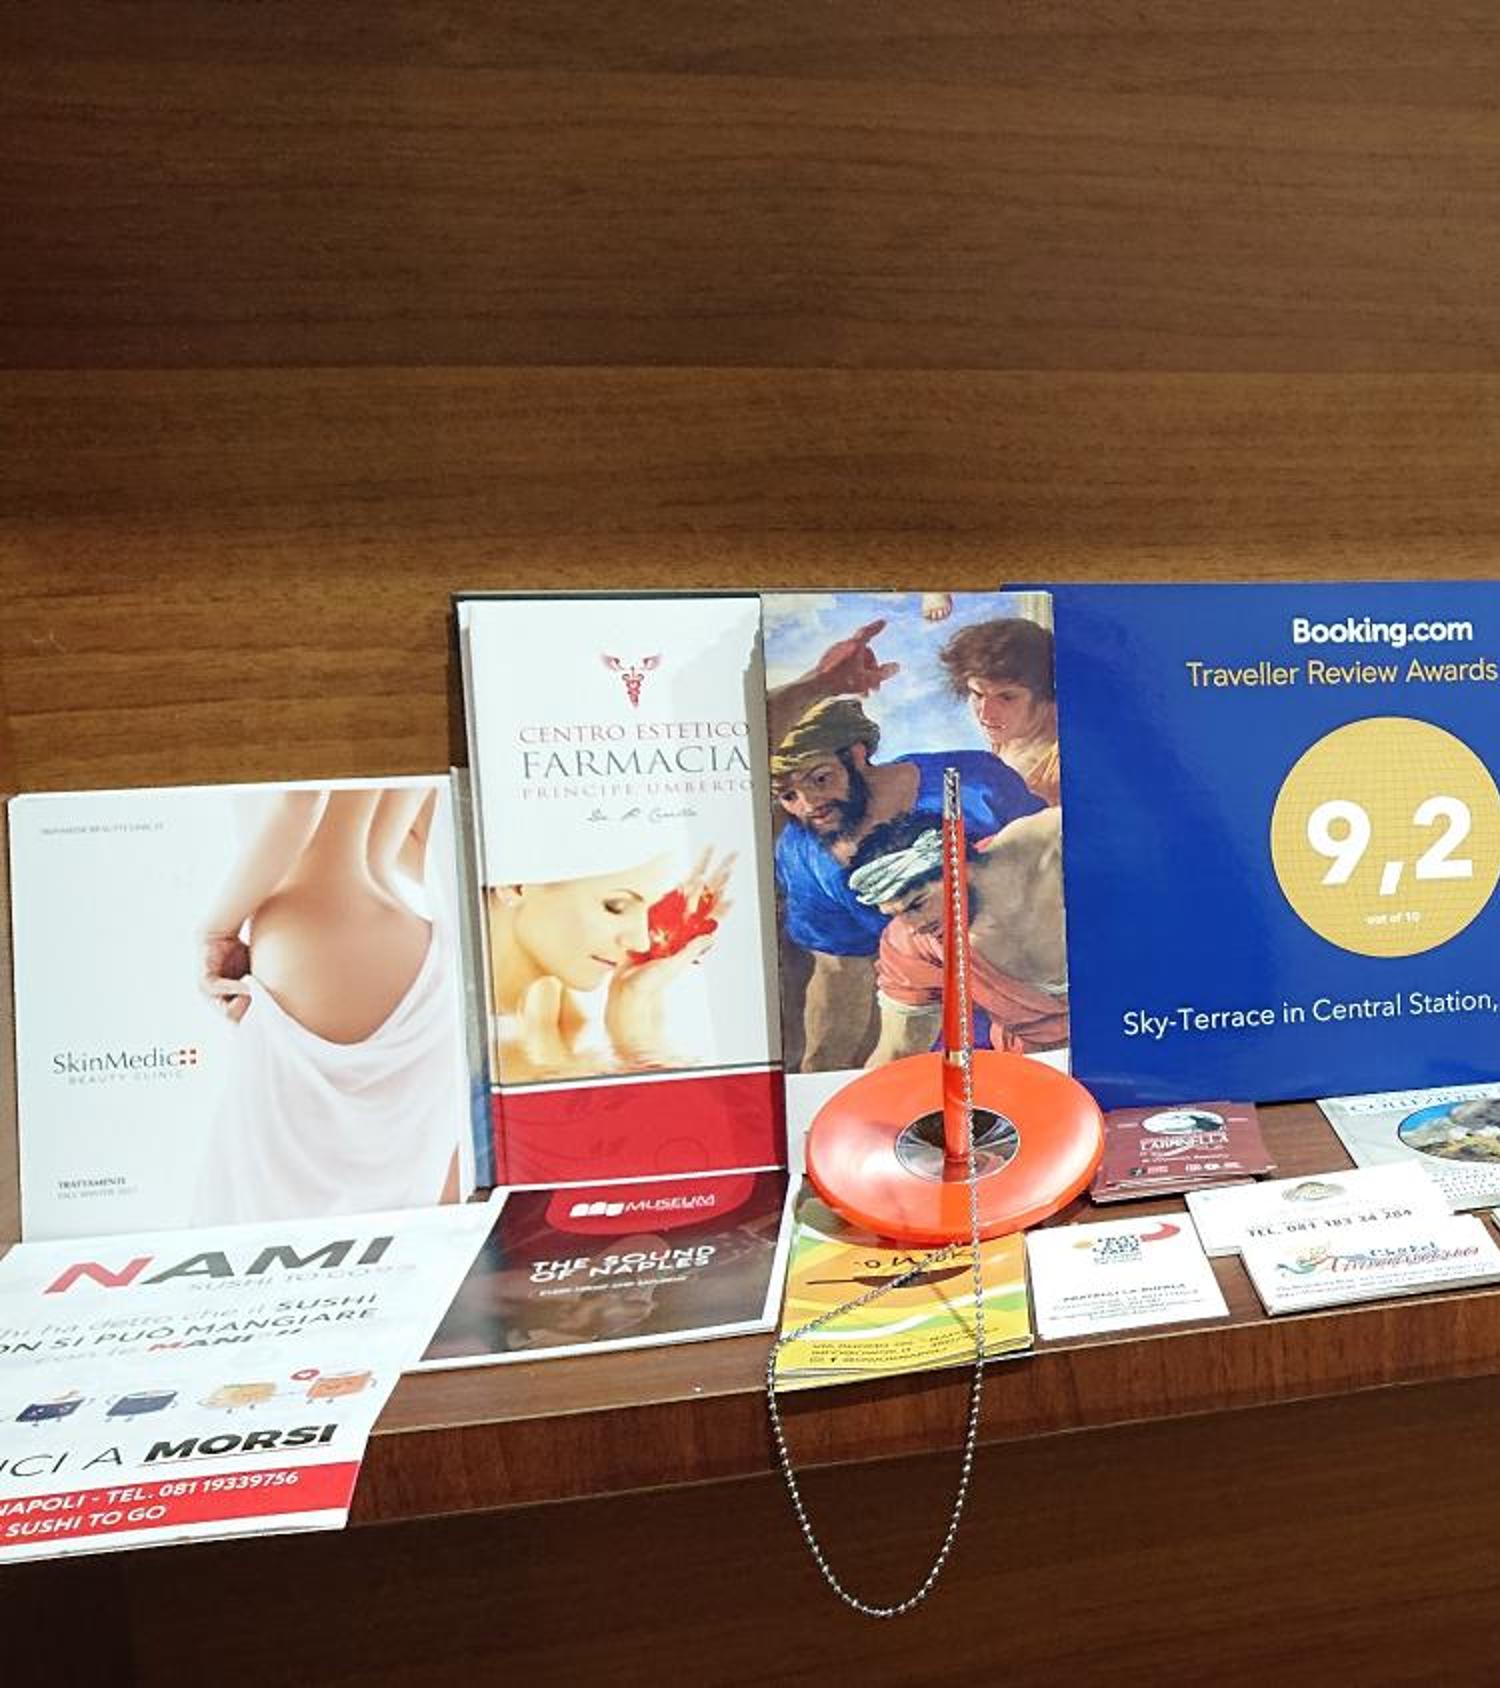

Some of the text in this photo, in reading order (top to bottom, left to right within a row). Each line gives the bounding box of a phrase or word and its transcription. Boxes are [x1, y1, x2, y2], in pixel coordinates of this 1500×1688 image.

[1291, 617, 1474, 648] Booking.com
[1186, 661, 1300, 690] Traveller
[1307, 658, 1399, 685] Review
[1405, 655, 1499, 682] Awards
[519, 721, 750, 745] CENTRO ESTETICO
[522, 744, 752, 778] FARMACIA
[522, 778, 755, 800] PRINCIPE UMBERTO
[1306, 795, 1474, 897] 9,2
[1123, 1003, 1275, 1038] Sky-Terrace
[1283, 1001, 1306, 1024] in
[1312, 996, 1402, 1022] Central
[1408, 989, 1499, 1017] Station,
[53, 1047, 180, 1075] SkinMedic
[625, 1193, 716, 1212] MUSEUM
[44, 1236, 394, 1294] NAMI
[529, 1255, 710, 1284] OF NAPLES
[532, 1245, 717, 1274] THE SOUND
[278, 1294, 378, 1313] SUSHI
[50, 1336, 85, 1350] SI
[184, 1307, 380, 1336] MANGIARE
[82, 1446, 124, 1470] A
[143, 1424, 338, 1463] MORSI
[0, 1494, 86, 1517] NAPOLI
[106, 1486, 153, 1507] TEL.
[159, 1480, 196, 1497] 081
[202, 1470, 298, 1495] 19339756
[5, 1504, 168, 1538] SUSHI TO GO
